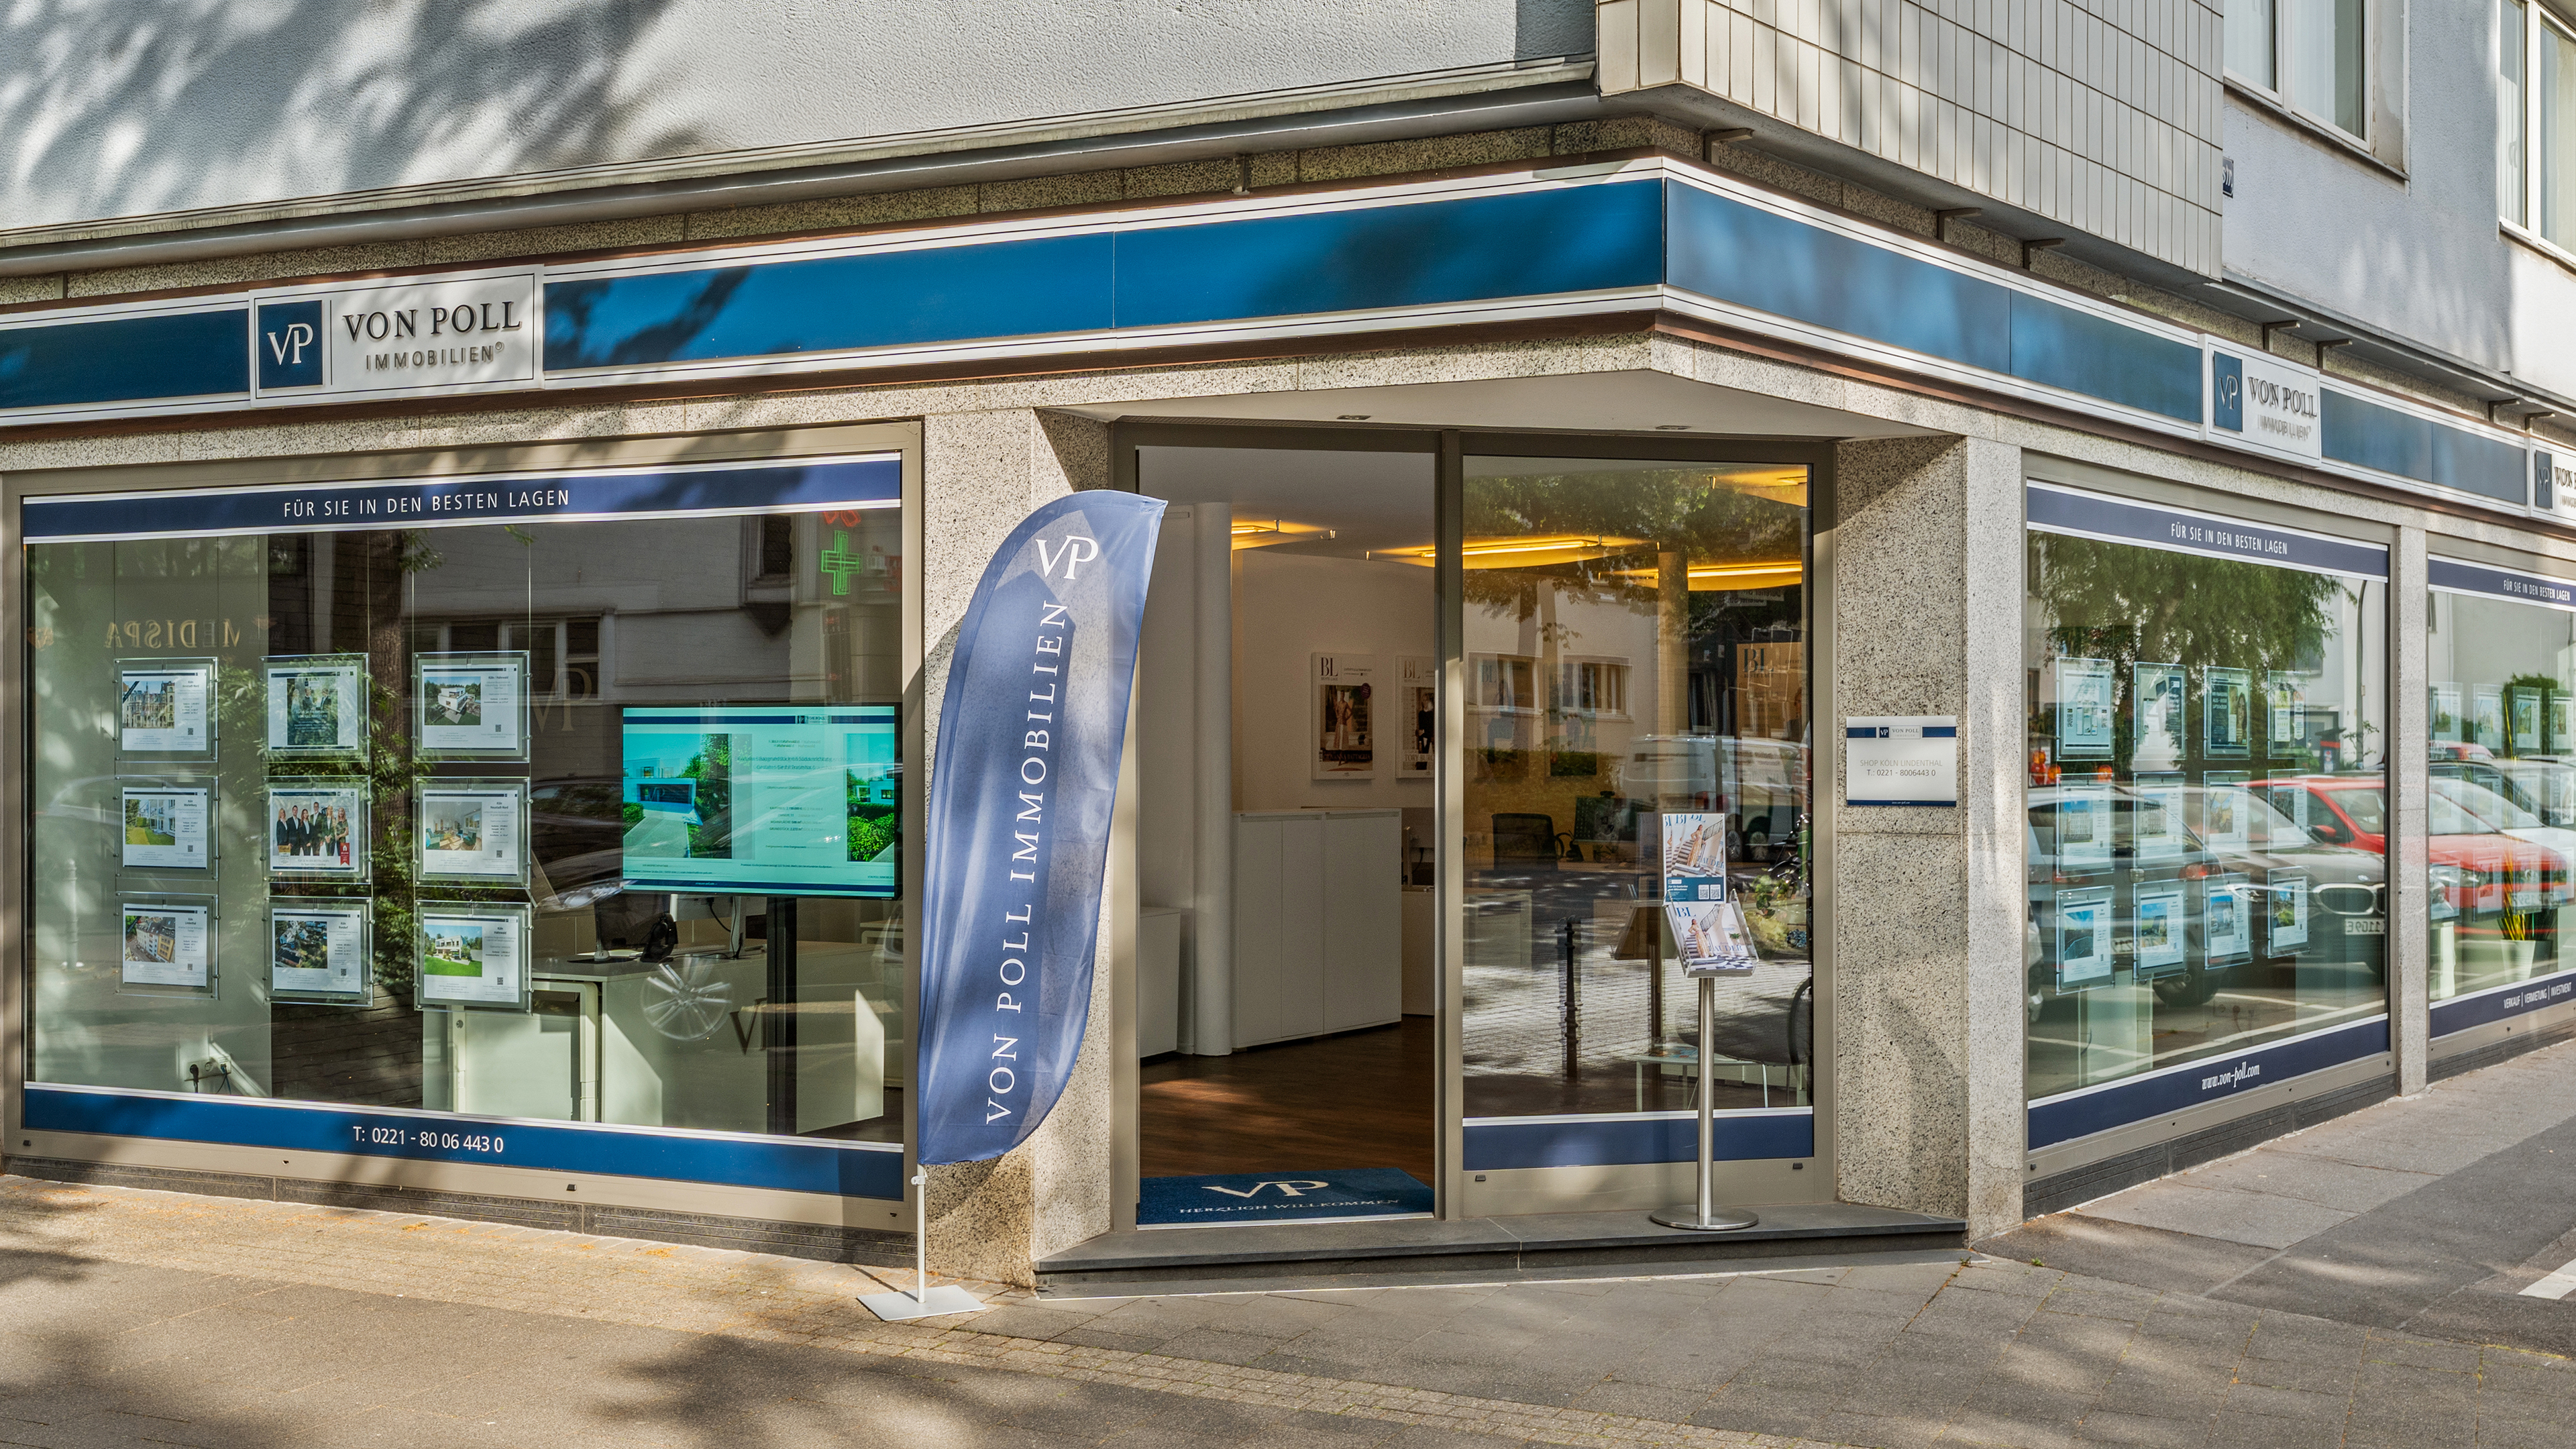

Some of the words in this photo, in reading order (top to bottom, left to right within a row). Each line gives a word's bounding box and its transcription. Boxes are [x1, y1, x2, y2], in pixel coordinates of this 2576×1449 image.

[343, 309, 418, 341] VON
[431, 301, 522, 335] POLL
[268, 323, 313, 366] VP
[2218, 374, 2239, 410] VP
[2248, 376, 2279, 408] VON
[2282, 387, 2317, 418] POLL
[2554, 466, 2573, 488] VON
[284, 498, 315, 517] FÜR
[324, 499, 349, 516] SIE
[360, 498, 377, 515] IN
[387, 496, 421, 513] DEN
[432, 492, 498, 511] BESTEN
[509, 489, 569, 508] LAGEN
[2171, 522, 2186, 539] FÜR
[2190, 527, 2202, 541] SIE
[2205, 529, 2213, 543] IN
[2217, 531, 2232, 546] DEN
[2235, 534, 2261, 551] BESTEN
[2265, 539, 2288, 555] LAGEN
[1035, 535, 1099, 580] VP
[2504, 578, 2512, 591] FÜR
[2522, 583, 2528, 594] IN
[2529, 584, 2538, 596] DEN
[2540, 586, 2555, 599] BESTEN
[2557, 588, 2570, 601] LAGEN
[1320, 657, 1338, 677] BL
[1403, 660, 1420, 679] BL
[1010, 600, 1068, 883] IMMOBILIEN
[1880, 758, 1898, 767] KÖLN
[1676, 907, 1696, 917] BL
[996, 904, 1032, 1014] POLL
[2504, 995, 2521, 1009] VERKAUF
[2524, 988, 2547, 1004] VERMIETUNG
[2551, 982, 2572, 997] INVESTMENT
[986, 1033, 1019, 1126] VON
[2202, 1061, 2260, 1090] www.von-poll.com
[353, 1126, 366, 1142] T:
[372, 1127, 405, 1144] 0221
[420, 1131, 437, 1148] 80
[441, 1132, 459, 1150] 06
[463, 1134, 490, 1152] 443
[494, 1136, 504, 1153] 0
[1201, 1180, 1330, 1198] VP
[1179, 1205, 1268, 1214] HERZLICH
